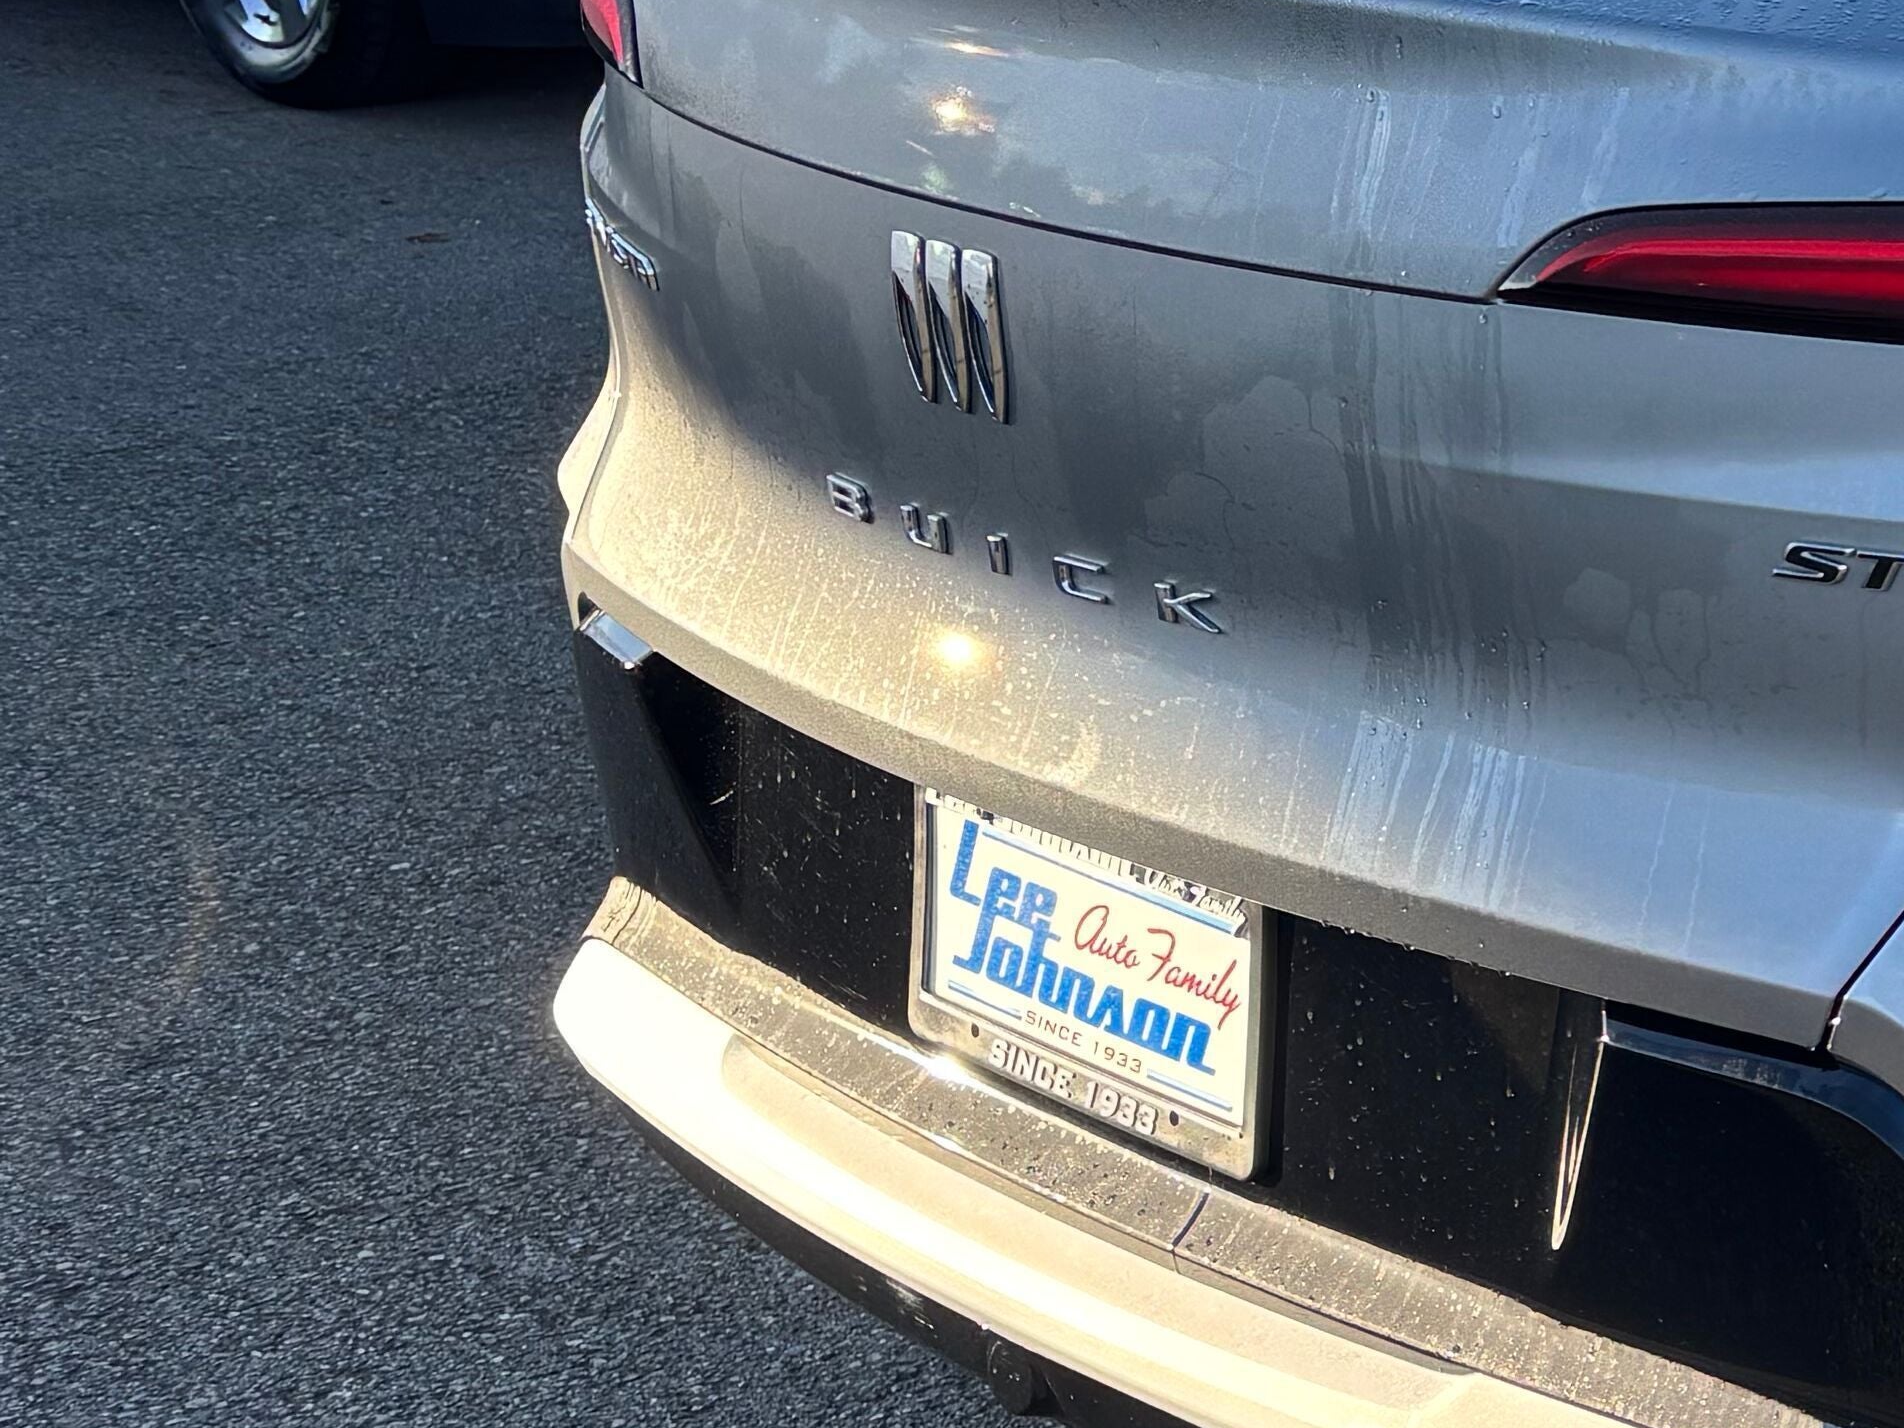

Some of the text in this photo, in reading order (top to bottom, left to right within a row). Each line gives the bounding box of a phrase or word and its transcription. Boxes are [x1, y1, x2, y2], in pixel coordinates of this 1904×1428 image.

[826, 473, 1225, 634] BUICK
[950, 819, 1058, 929] Lee
[952, 909, 1216, 1076] Johnson
[1073, 905, 1241, 1031] Auto Family
[988, 1038, 1160, 1136] SINCE 1933
[1024, 1009, 1143, 1075] SINCE 1933
